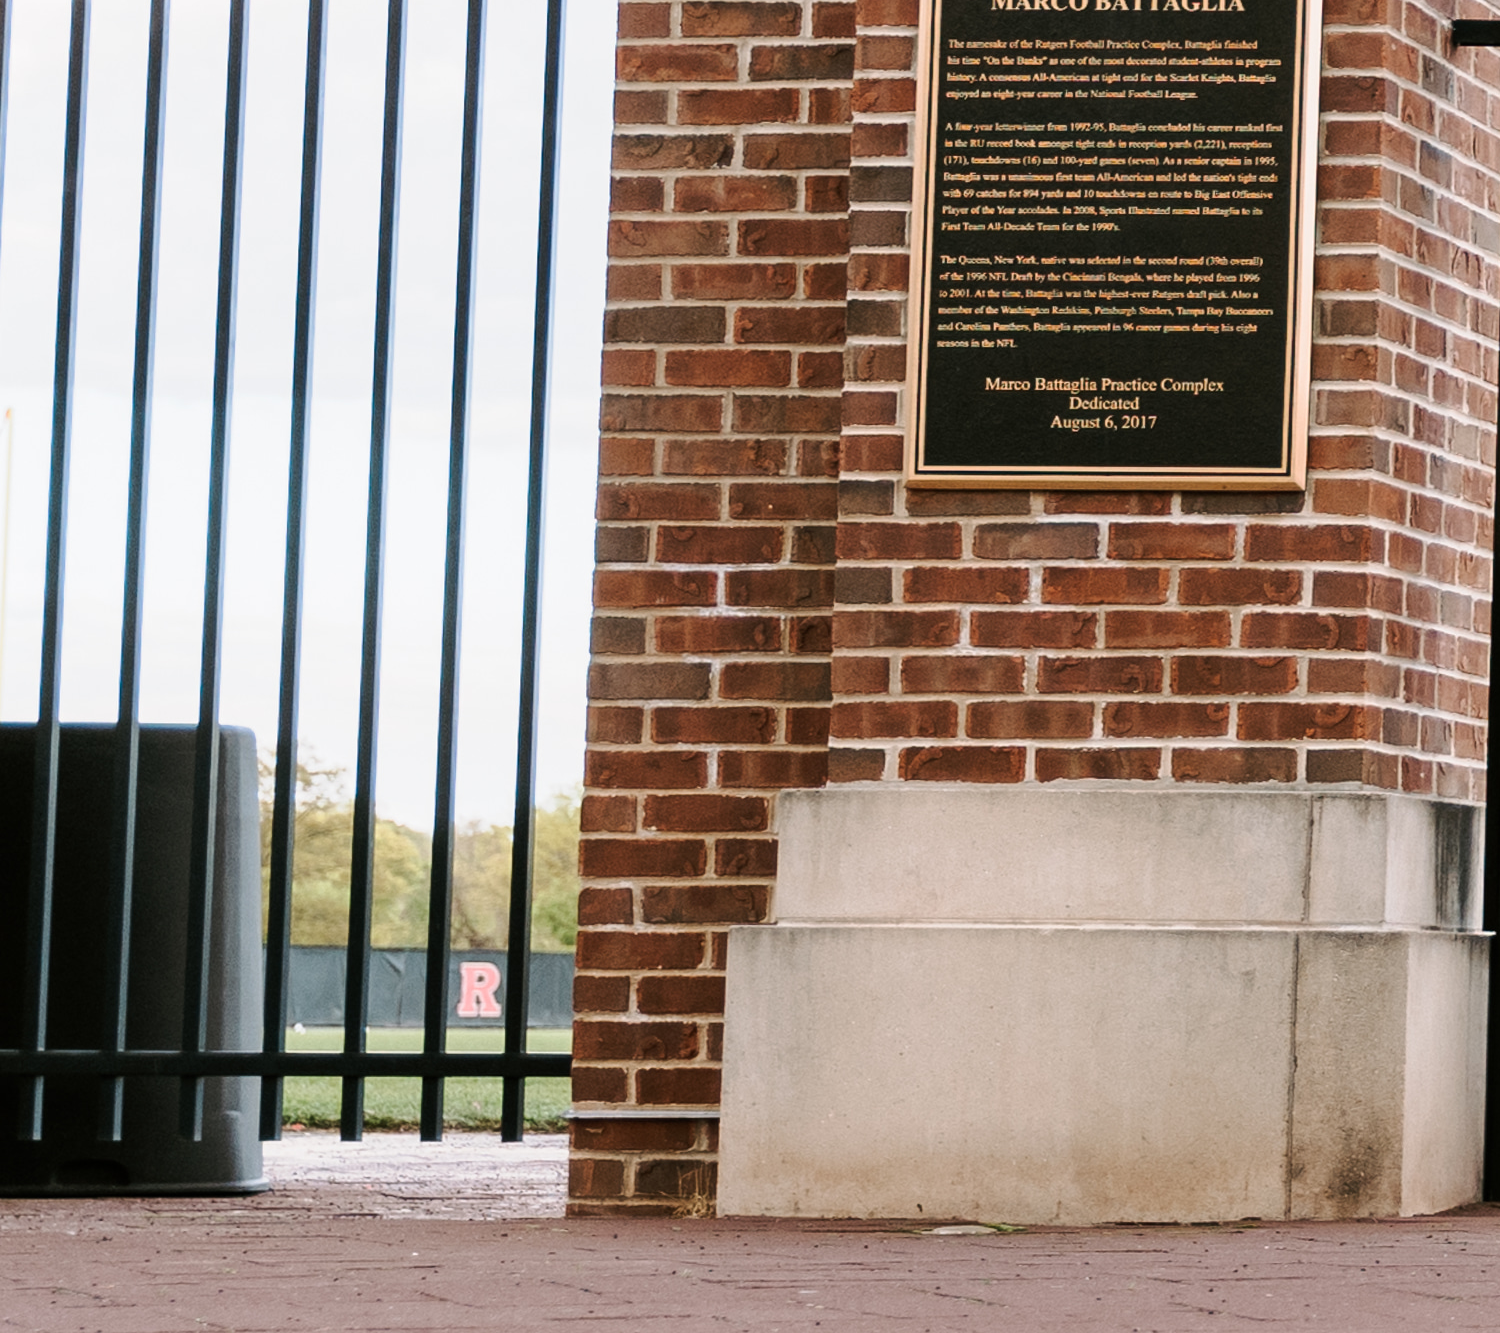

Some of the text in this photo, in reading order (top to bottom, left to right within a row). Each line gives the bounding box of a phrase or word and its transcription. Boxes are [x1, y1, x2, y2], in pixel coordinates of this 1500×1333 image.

[985, 377, 1224, 395] Marco Battaglia Practice Complex
[1069, 396, 1139, 410] Dedicated
[1050, 415, 1157, 432] August 6, 2017
[456, 961, 502, 1018] R
